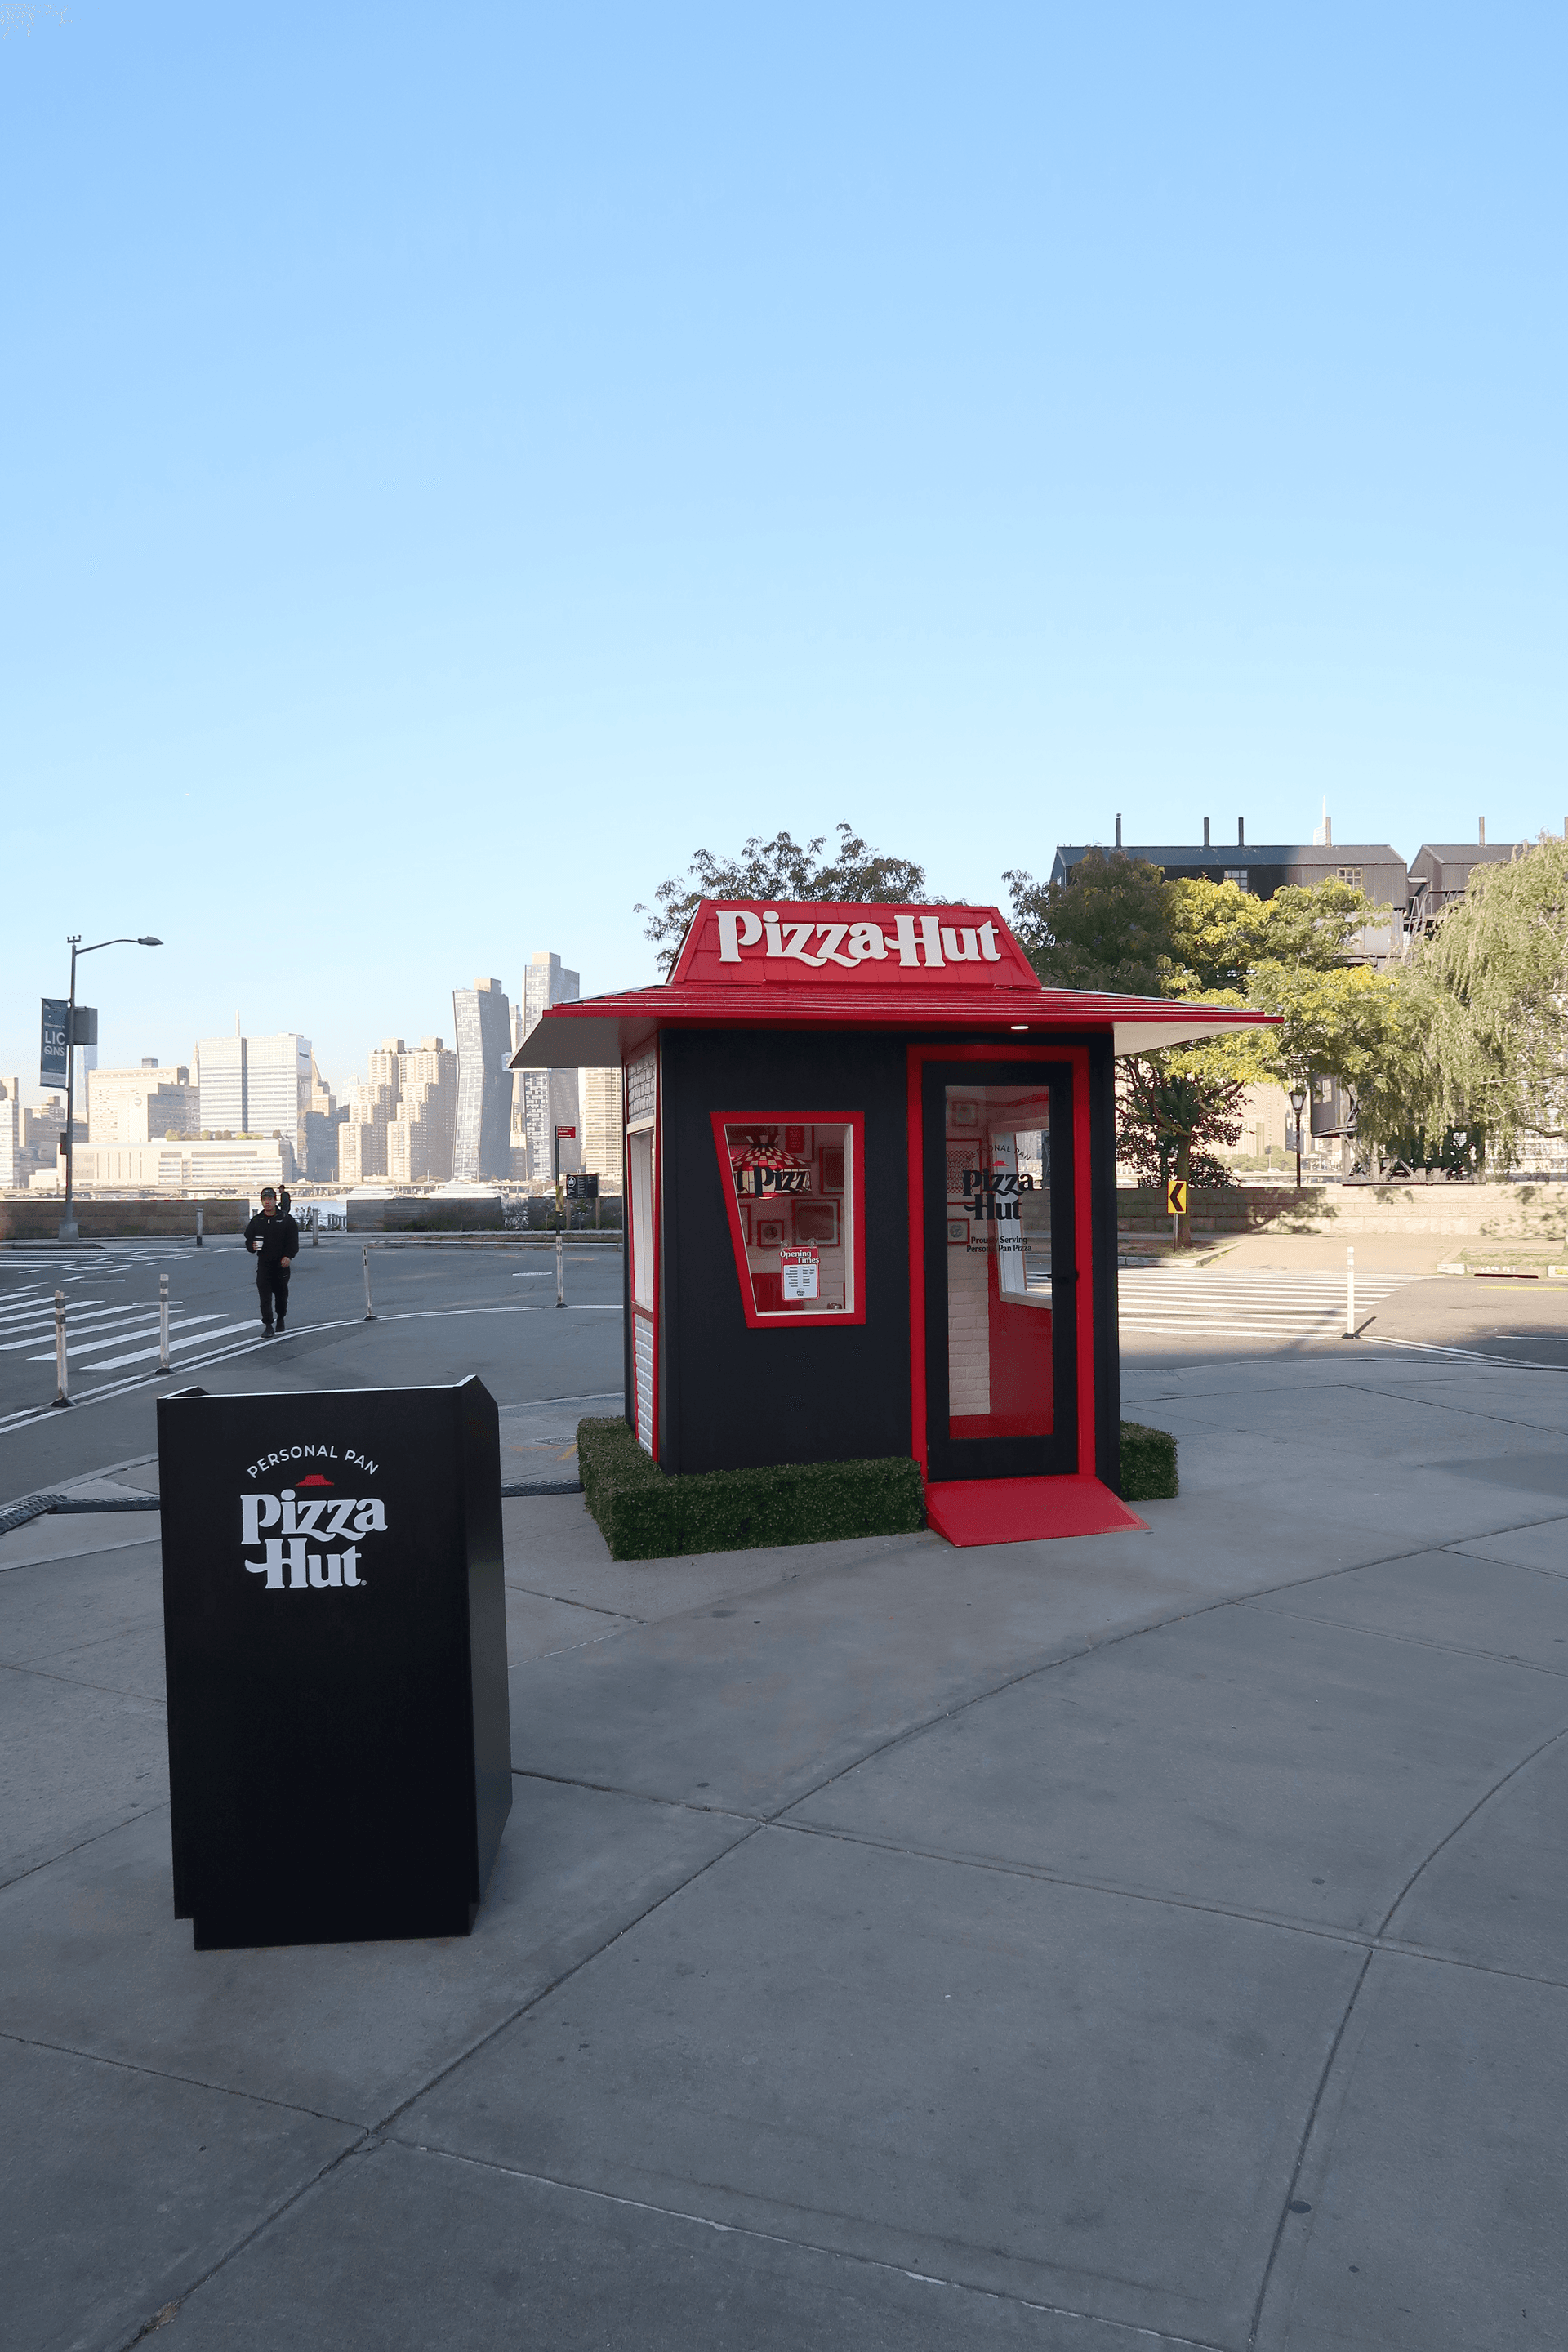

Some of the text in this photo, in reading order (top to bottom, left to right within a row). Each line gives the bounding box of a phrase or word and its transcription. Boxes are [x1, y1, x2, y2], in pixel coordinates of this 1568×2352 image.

[715, 910, 1001, 968] Pizza Hut
[44, 1030, 65, 1045] LIC
[44, 1045, 65, 1057] QNS
[966, 1144, 1031, 1161] ERSONAL PAN
[962, 1168, 1034, 1197] Pizza
[964, 1193, 1022, 1221] Hut
[971, 1236, 1027, 1245] Prou Serving
[1013, 1244, 1032, 1252] Pizza
[780, 1250, 812, 1259] Opening
[247, 1444, 379, 1479] PERSONAL PAN
[239, 1489, 389, 1545] Pizza
[244, 1537, 362, 1589] Hut
